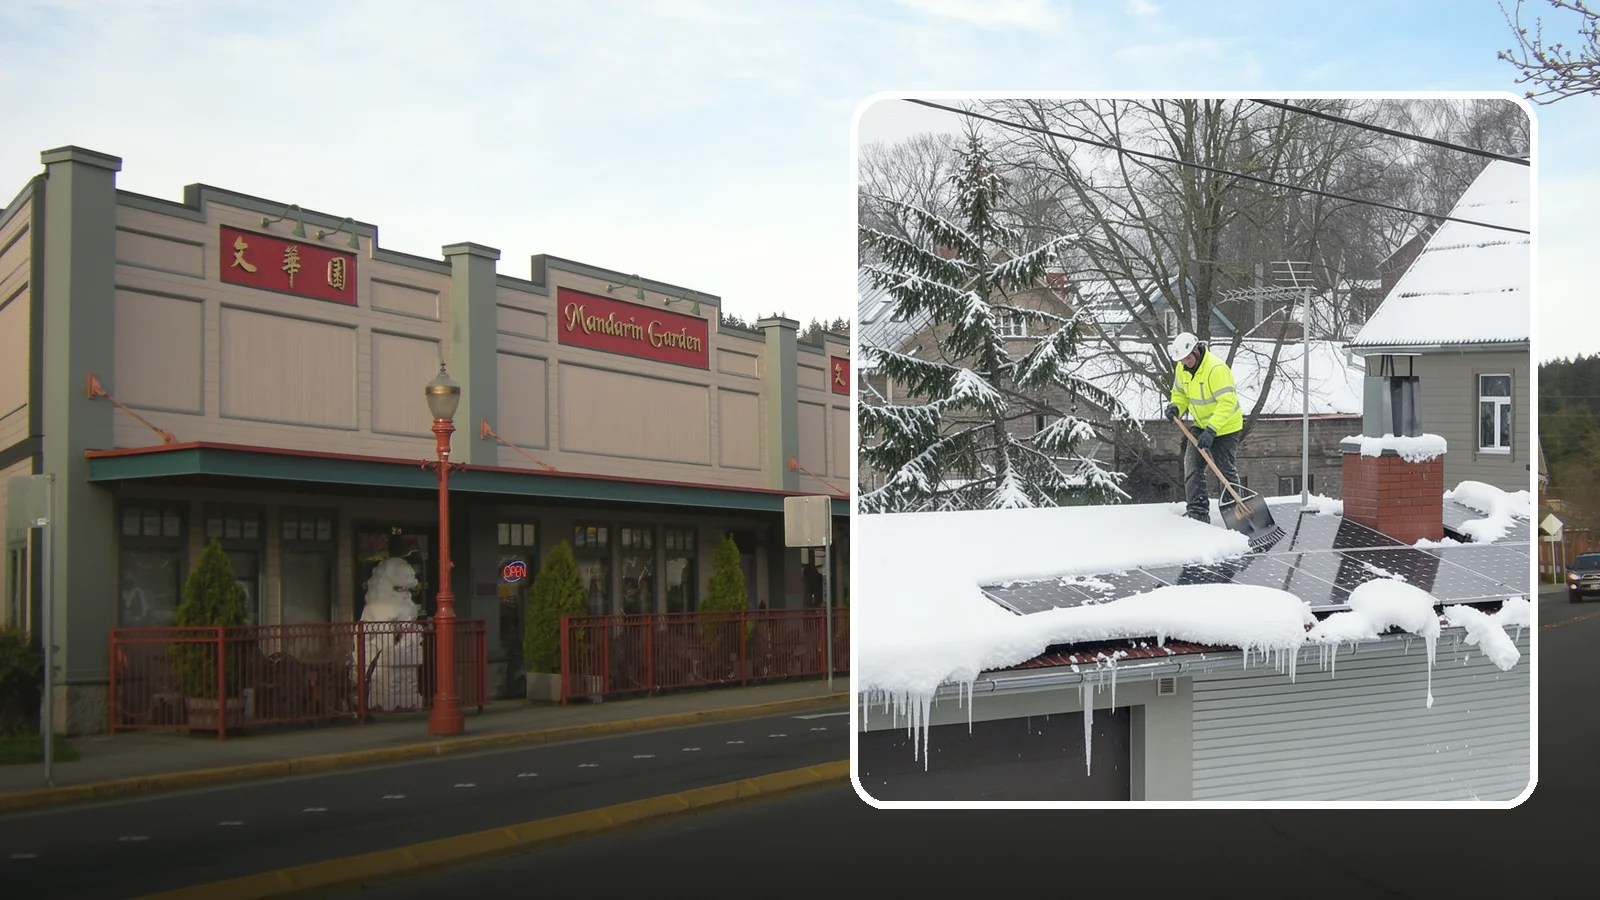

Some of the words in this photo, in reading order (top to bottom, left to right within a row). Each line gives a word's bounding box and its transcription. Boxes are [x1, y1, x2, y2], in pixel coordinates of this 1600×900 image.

[231, 236, 346, 290] 文華園
[564, 302, 644, 341] Mandarin
[648, 320, 701, 352] Garden
[503, 565, 527, 578] OPEN
